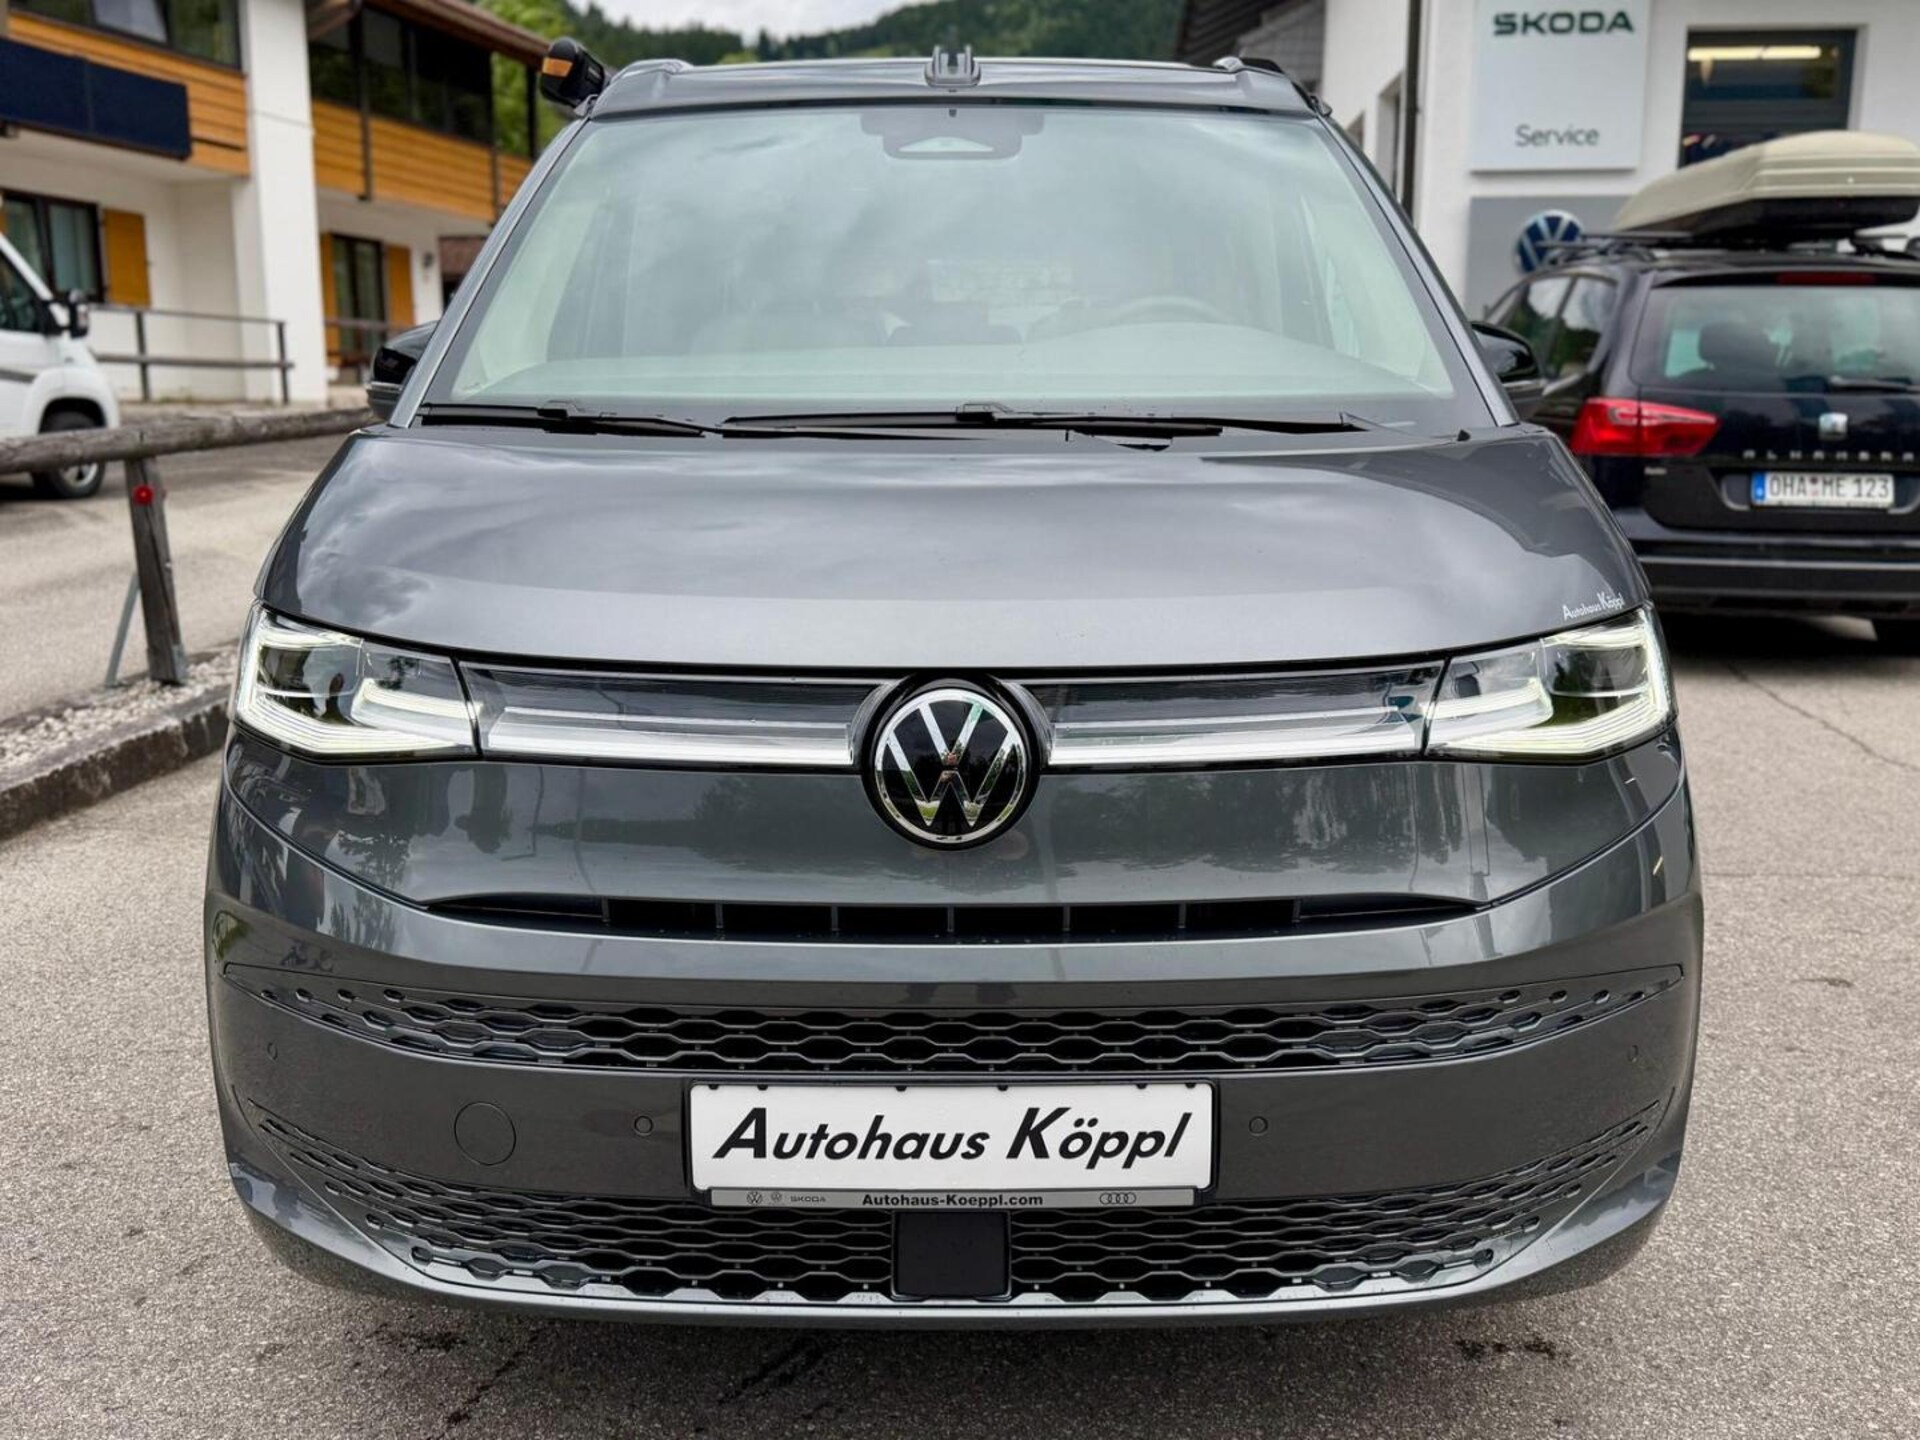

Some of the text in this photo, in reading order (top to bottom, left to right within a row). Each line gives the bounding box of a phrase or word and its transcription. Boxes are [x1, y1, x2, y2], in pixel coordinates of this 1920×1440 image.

[1493, 11, 1634, 36] SKODA
[1515, 124, 1599, 147] Service
[1852, 477, 1889, 498] 123
[712, 1107, 1193, 1170] Autohaus Köppl
[862, 1194, 1043, 1208] Autohaus-Koeppl.com
